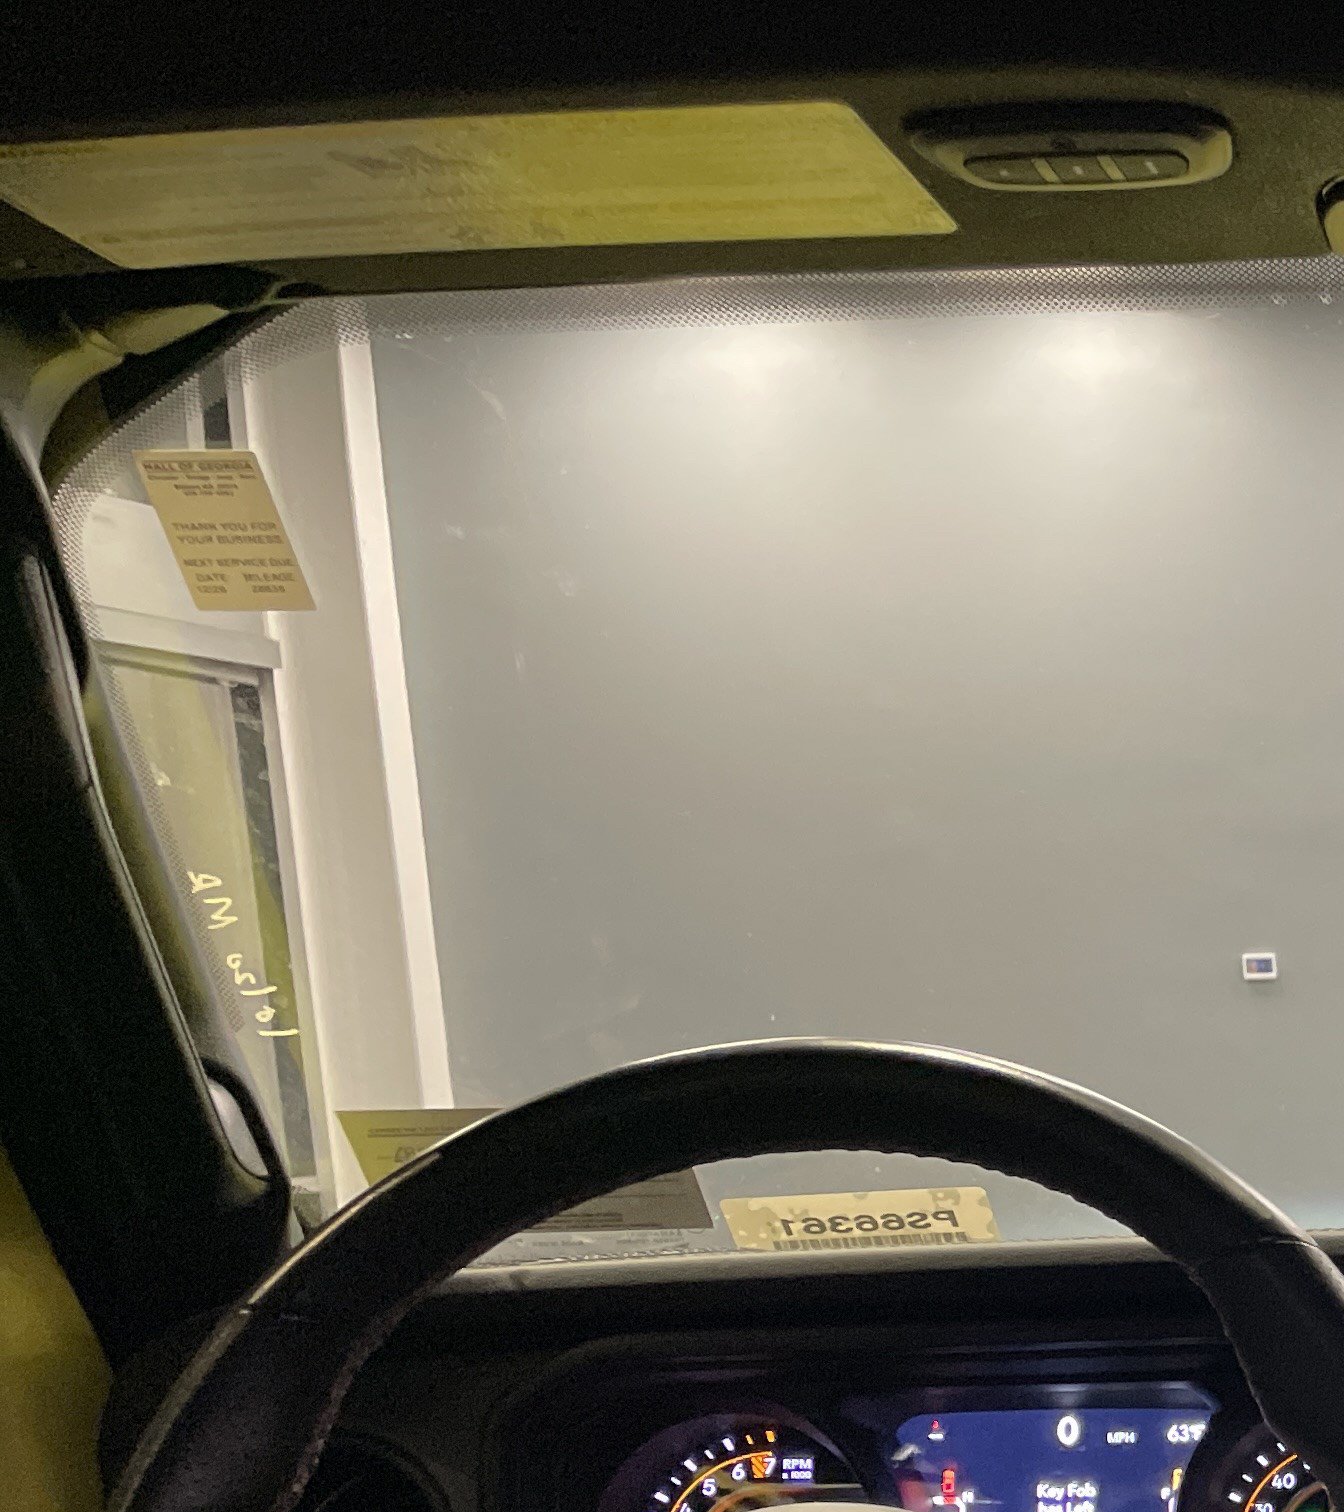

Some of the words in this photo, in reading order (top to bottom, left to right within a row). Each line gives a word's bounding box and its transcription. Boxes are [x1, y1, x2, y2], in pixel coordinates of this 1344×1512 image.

[172, 522, 218, 531] THANK
[220, 522, 248, 532] YOU
[250, 522, 277, 531] FOR
[176, 535, 214, 544] YOUR
[216, 535, 284, 544] BUSINESS
[183, 558, 214, 567] NEXT
[216, 558, 269, 567] SERVICE
[195, 573, 228, 582] DATE
[242, 573, 295, 582] MILEAGE
[1056, 1415, 1080, 1447] 0
[1106, 1431, 1136, 1444] MPH
[763, 1457, 777, 1478] 7
[782, 1458, 814, 1471] RPM
[731, 1462, 746, 1481] 6
[701, 1478, 717, 1497] 5
[1271, 1472, 1297, 1490] 40
[1036, 1482, 1065, 1501] Key
[1067, 1481, 1097, 1499] Fob
